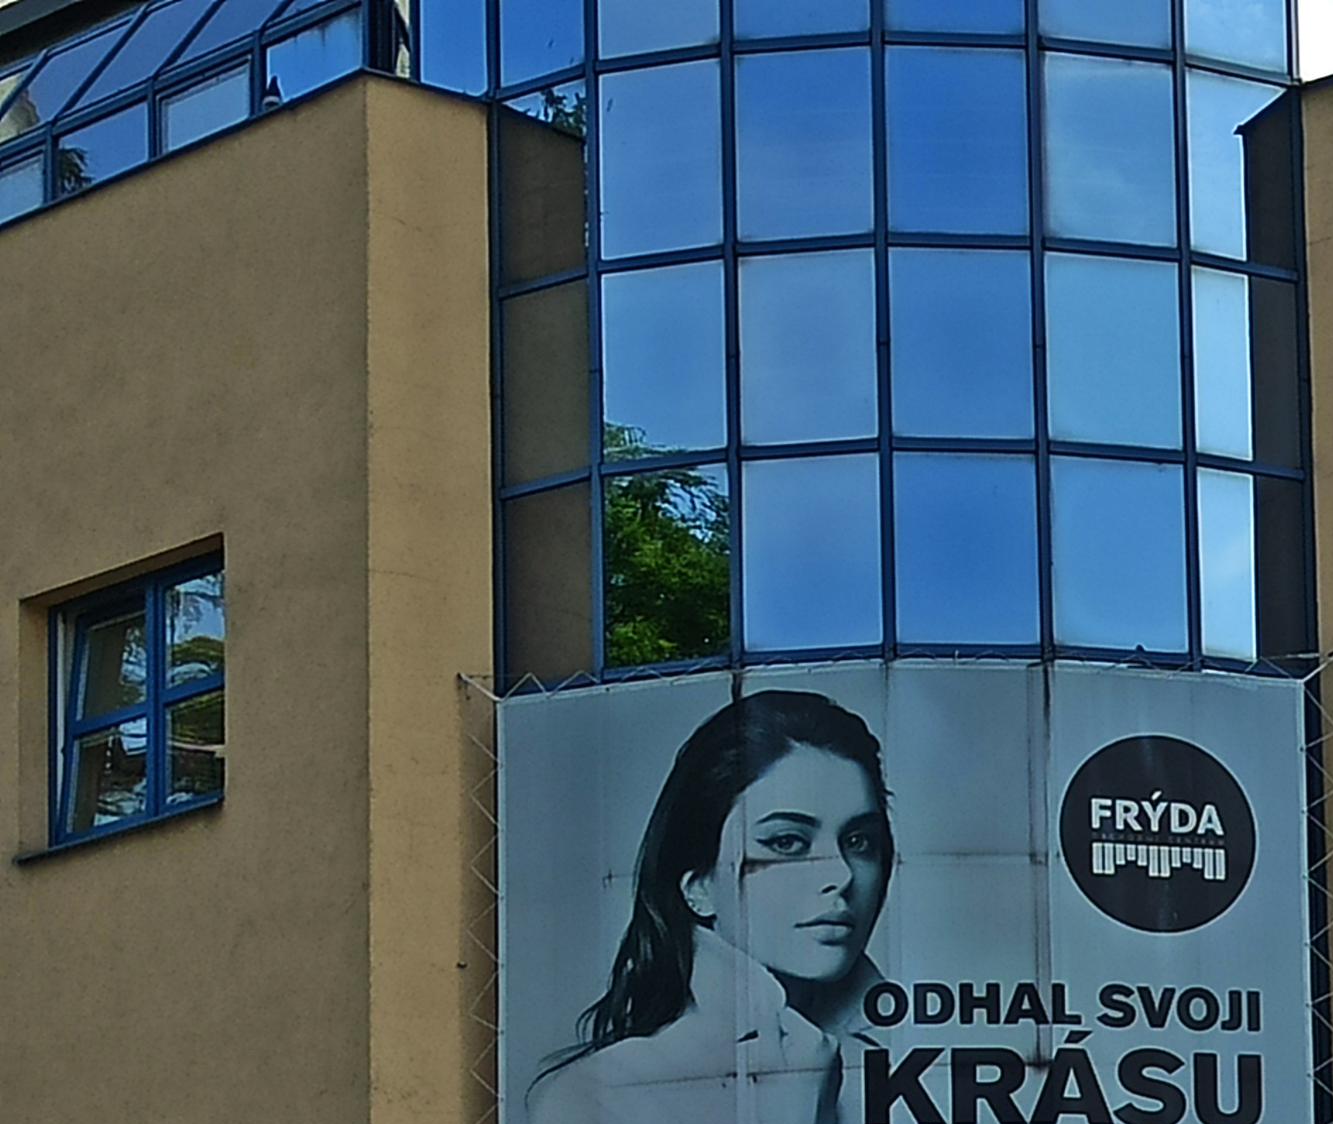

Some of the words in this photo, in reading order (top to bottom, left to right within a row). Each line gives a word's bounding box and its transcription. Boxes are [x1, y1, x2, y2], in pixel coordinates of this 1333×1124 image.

[1091, 790, 1224, 835] FRÝDA
[863, 982, 1080, 1028] ODHAL
[1097, 986, 1262, 1032] SVOJI
